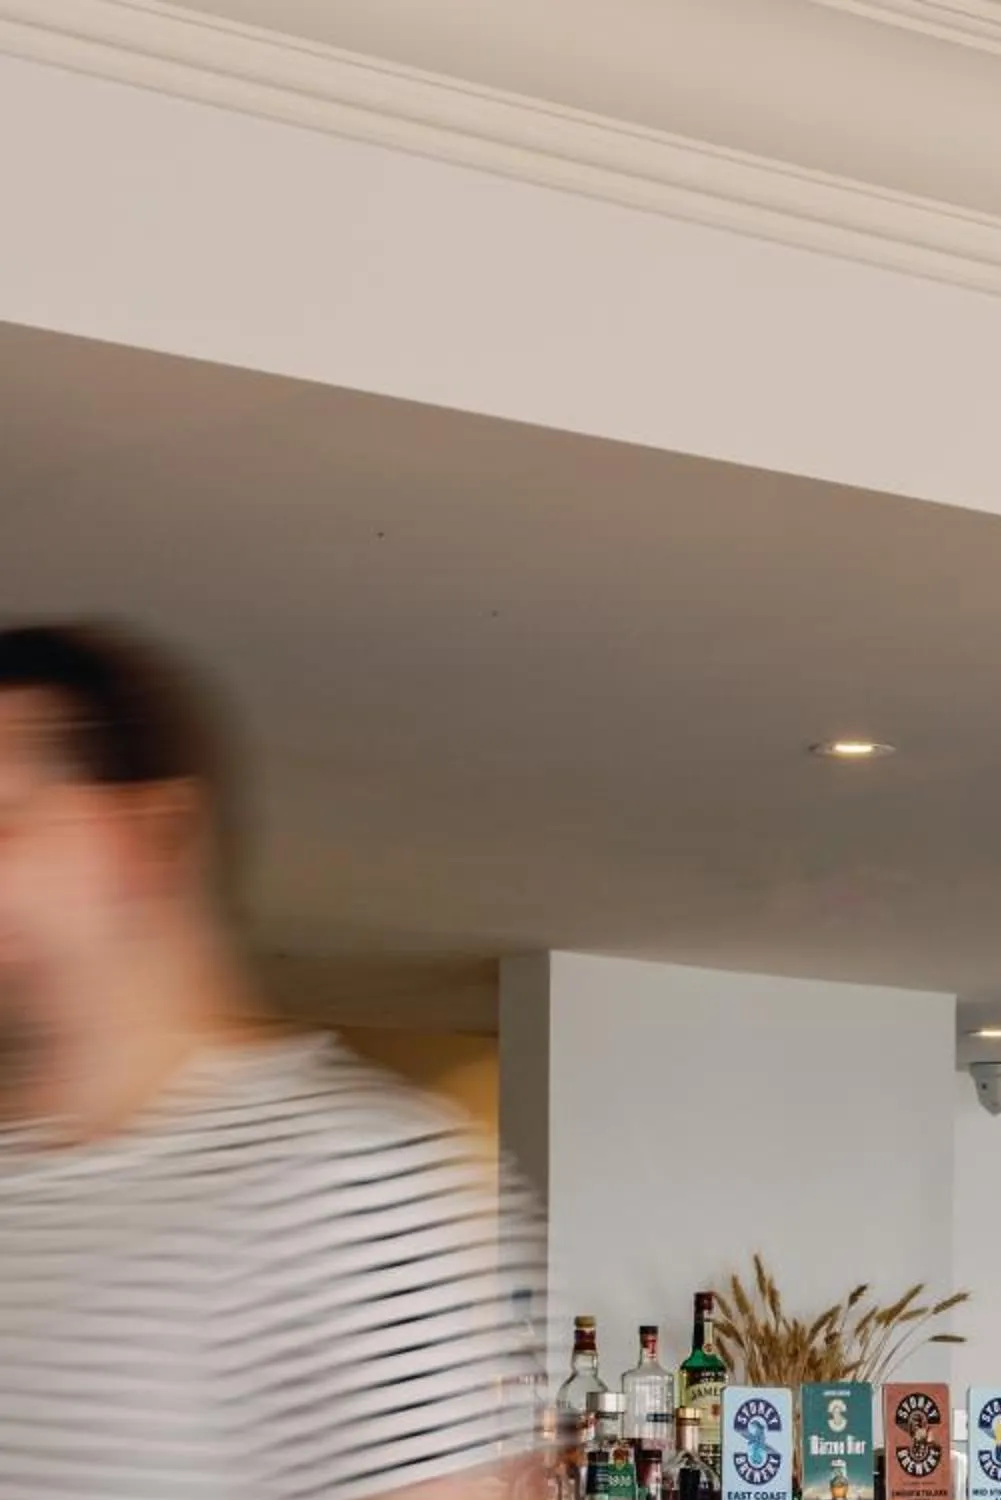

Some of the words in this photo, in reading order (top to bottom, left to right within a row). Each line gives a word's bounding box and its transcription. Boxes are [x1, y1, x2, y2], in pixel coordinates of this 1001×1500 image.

[735, 1455, 779, 1483] BREWERY
[727, 1491, 752, 1500] EAST
[754, 1491, 787, 1500] COAST
